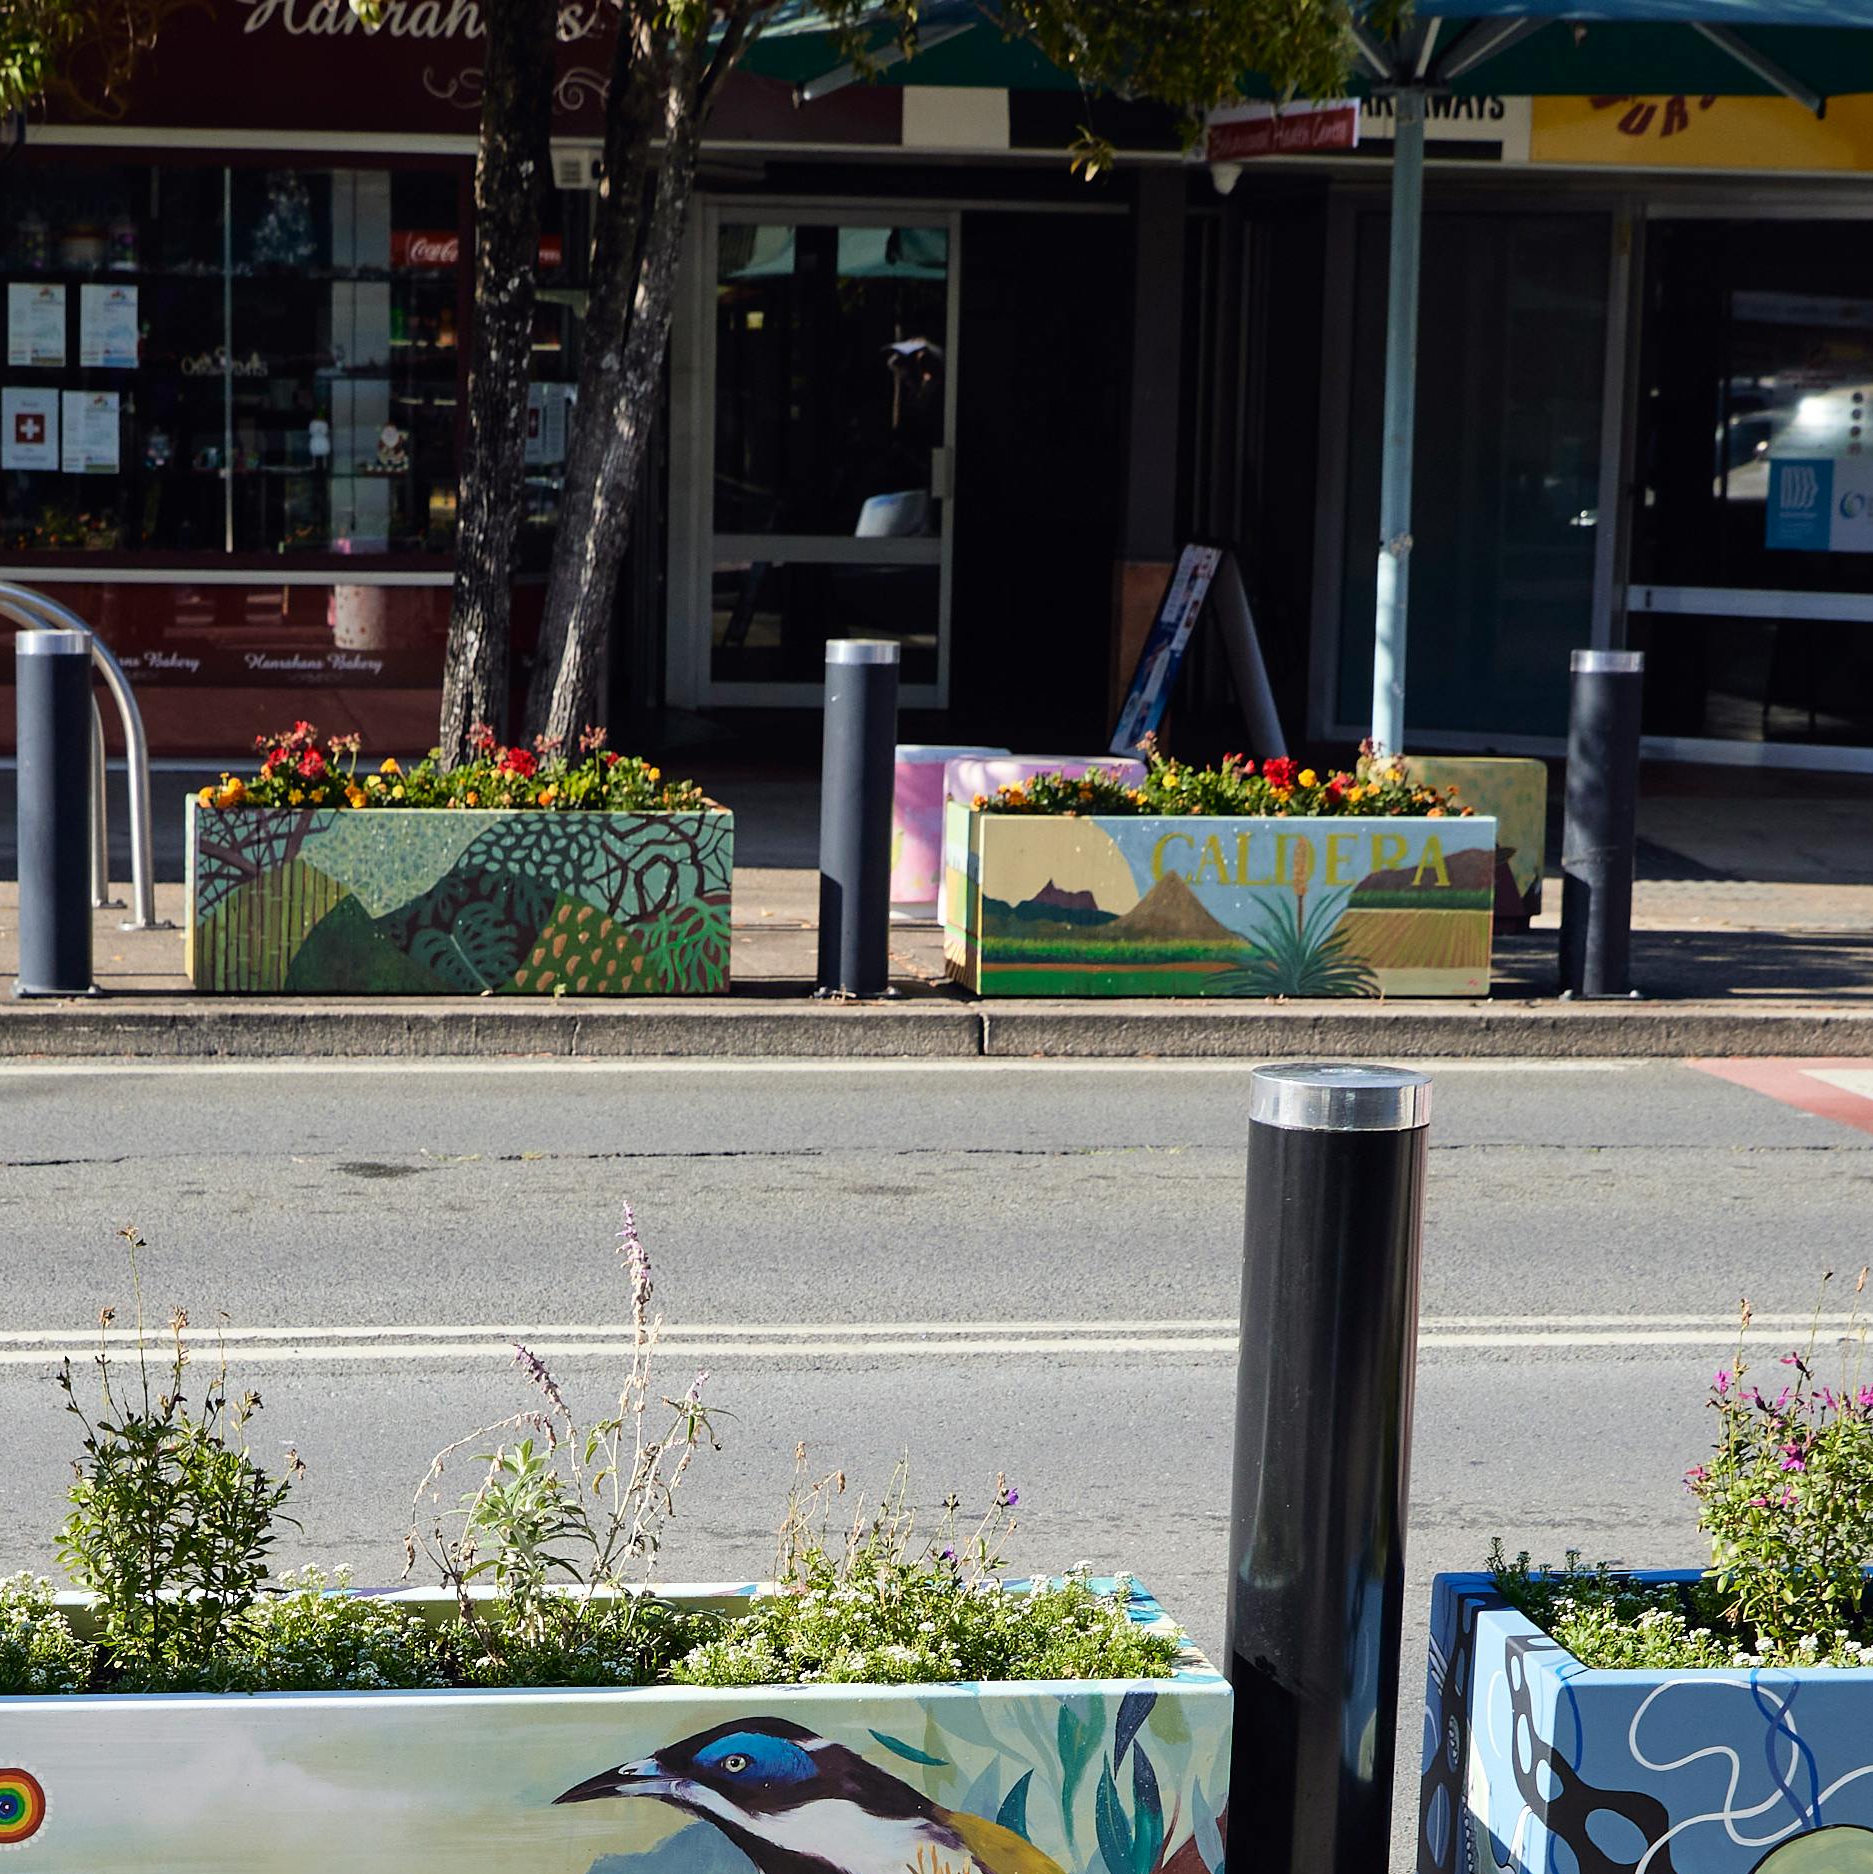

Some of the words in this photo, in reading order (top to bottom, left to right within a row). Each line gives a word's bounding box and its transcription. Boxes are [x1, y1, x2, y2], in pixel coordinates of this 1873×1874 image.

[142, 650, 201, 675] Bakery
[245, 652, 322, 672] Hanrahans
[327, 651, 384, 677] Bakery
[1151, 831, 1451, 888] CALDERA
